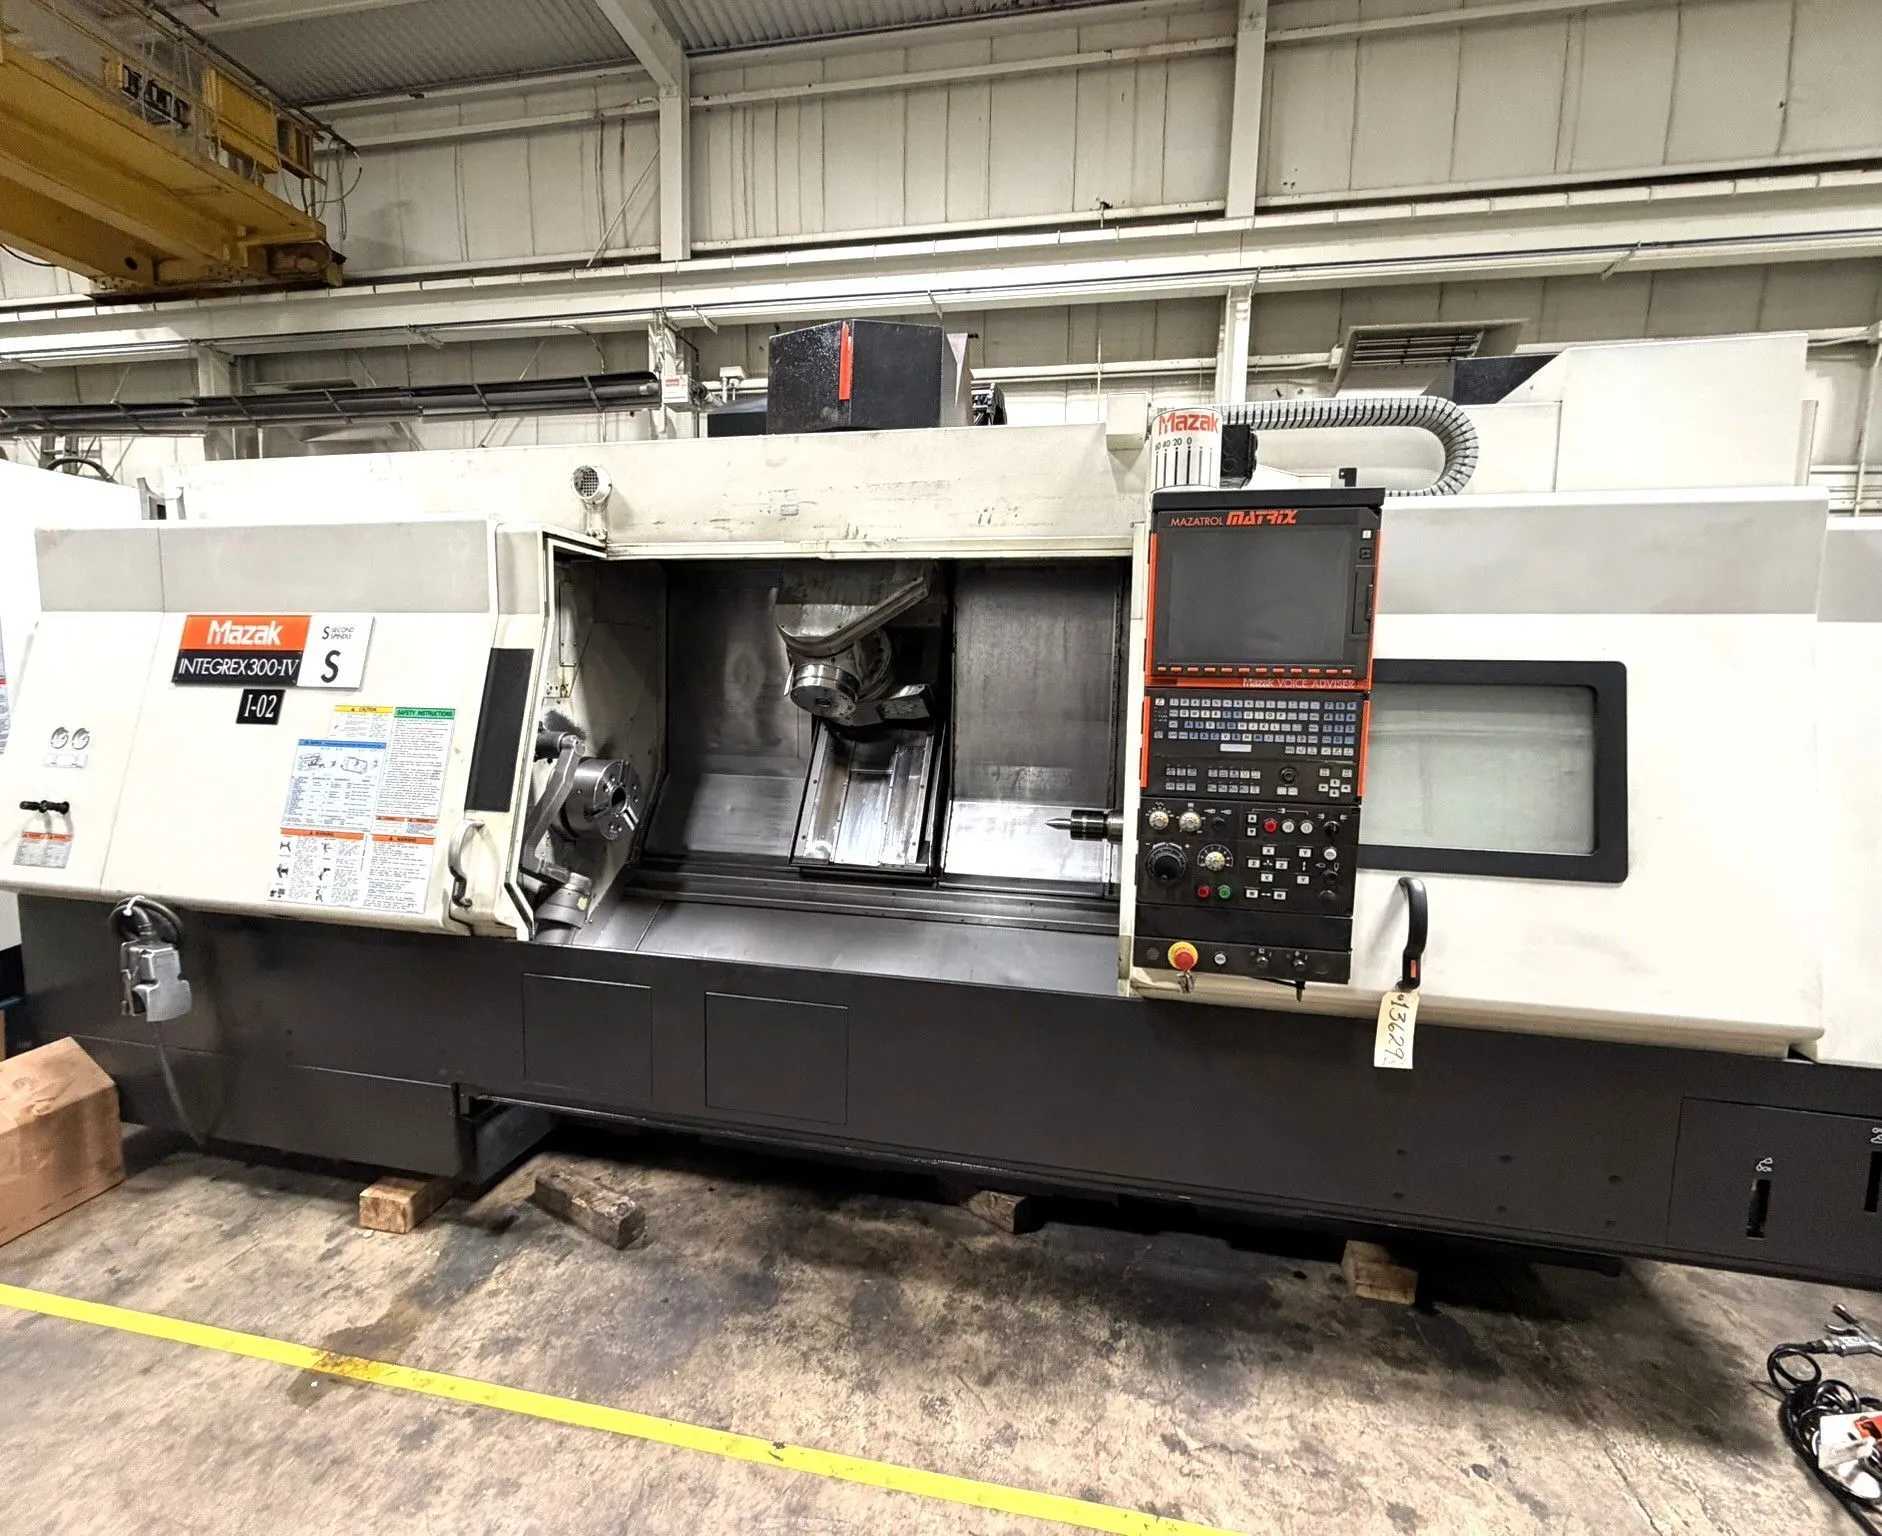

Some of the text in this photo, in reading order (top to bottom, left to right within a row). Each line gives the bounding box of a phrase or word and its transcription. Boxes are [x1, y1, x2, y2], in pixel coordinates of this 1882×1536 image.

[1158, 412, 1220, 436] Mazak
[1172, 437, 1183, 447] 20
[1170, 509, 1297, 527] MAZATROL MATRIX
[206, 619, 284, 645] Mazak
[321, 625, 331, 640] S
[178, 657, 247, 676] INTEGREX
[320, 649, 341, 684] S
[1276, 679, 1311, 689] VOICE
[1312, 679, 1355, 689] ADVISER
[243, 694, 278, 718] I-02
[396, 709, 454, 718] SAFETY INSTRUCTIONS
